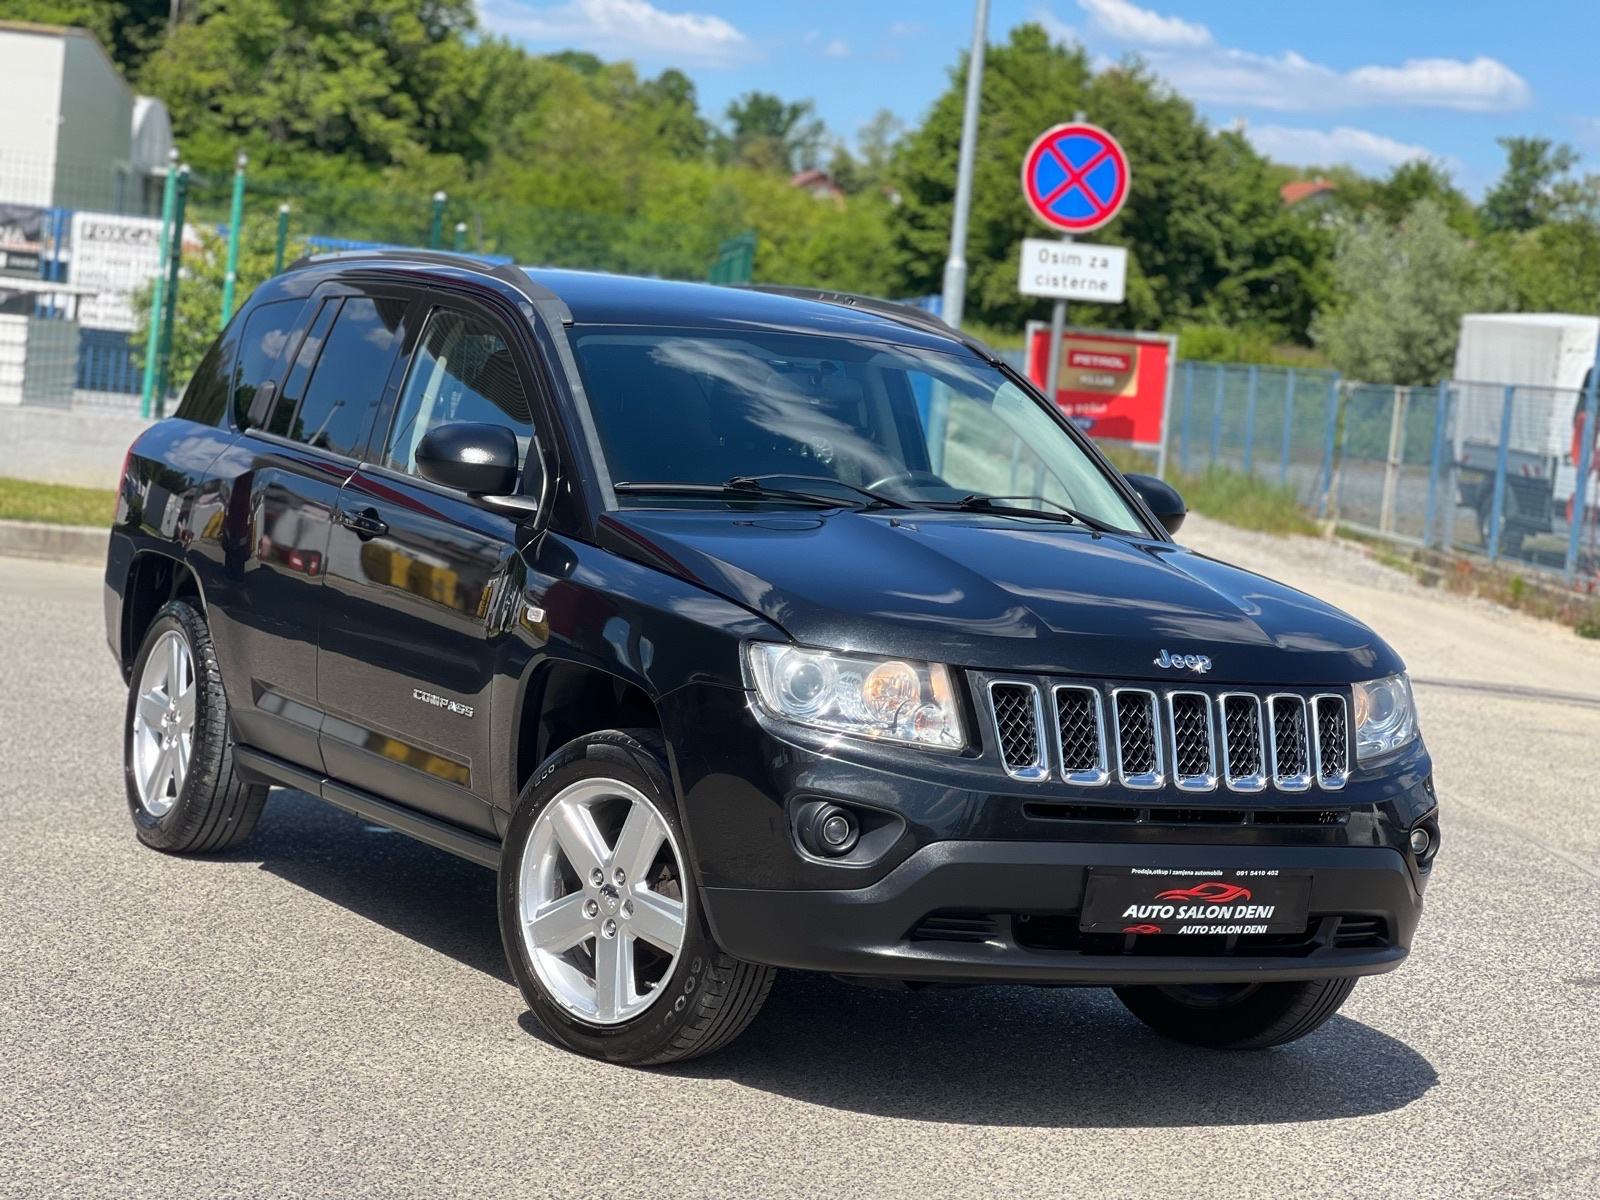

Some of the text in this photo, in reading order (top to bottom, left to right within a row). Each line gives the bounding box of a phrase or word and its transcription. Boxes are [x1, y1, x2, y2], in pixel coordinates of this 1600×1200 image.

[1038, 248, 1109, 268] Osim za
[1035, 273, 1109, 291] cisterne
[1154, 649, 1212, 674] Jeep
[413, 688, 474, 718] COMPASS
[1122, 905, 1275, 919] AUTO SALON DENI
[1178, 925, 1268, 934] AUTO SALON DENI
